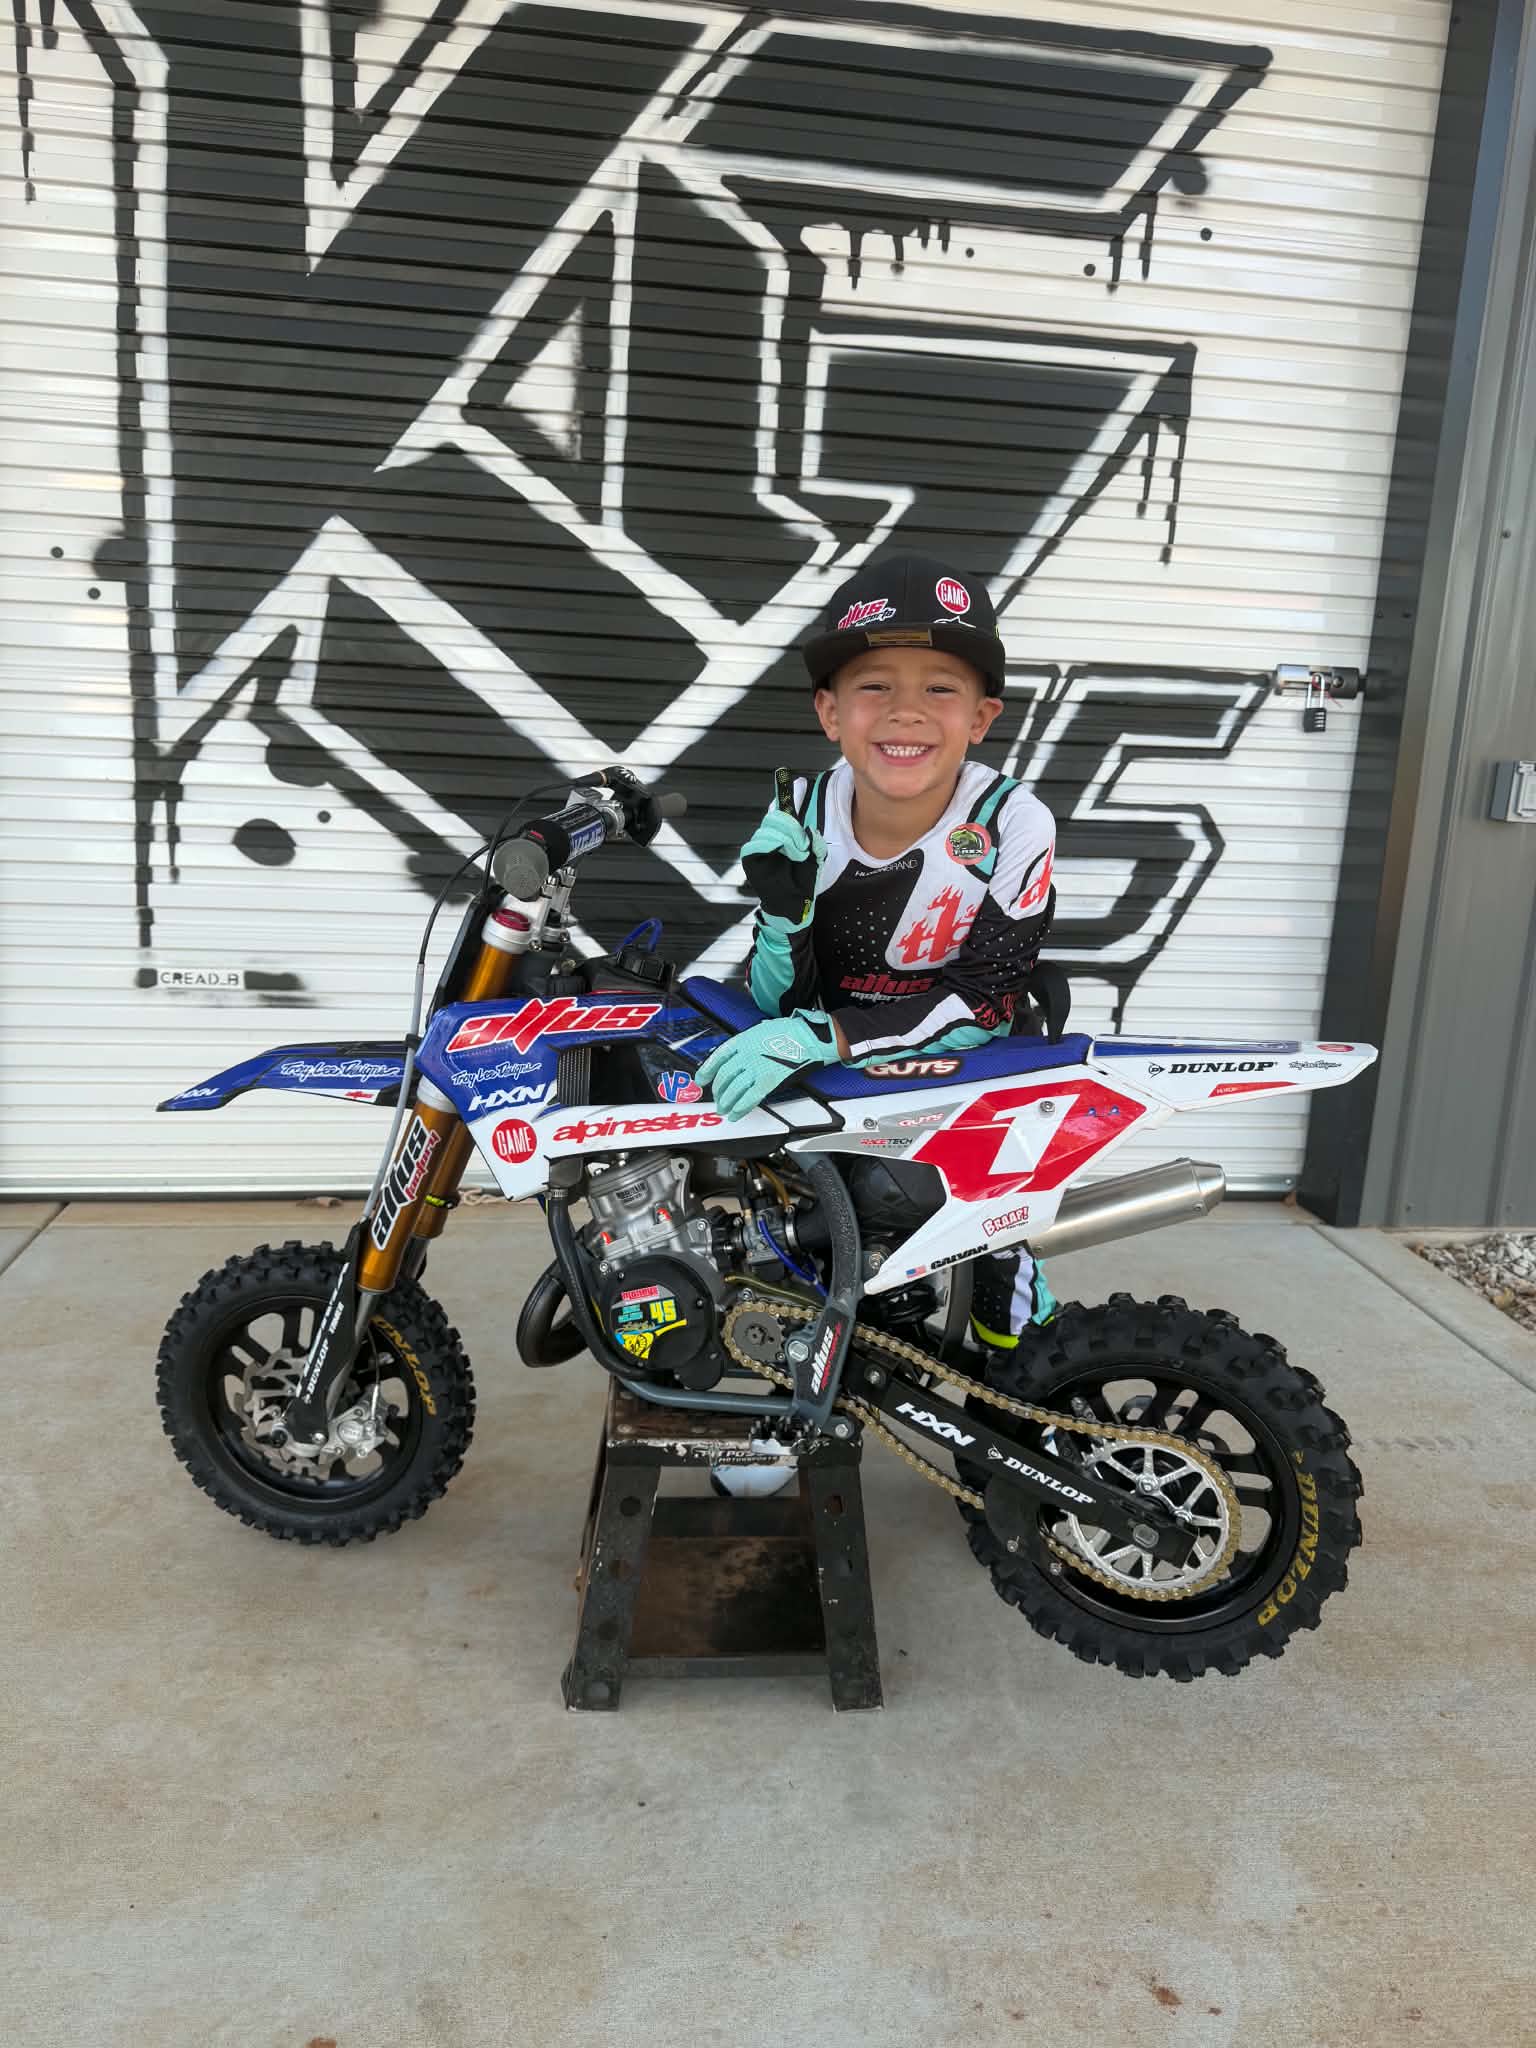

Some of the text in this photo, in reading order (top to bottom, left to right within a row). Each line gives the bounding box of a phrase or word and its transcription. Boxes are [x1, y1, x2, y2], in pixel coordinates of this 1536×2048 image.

[940, 583, 968, 608] GAME
[864, 1059, 960, 1076] GUTS
[1168, 1061, 1275, 1074] DUNLOP
[468, 1084, 546, 1111] HXN
[661, 1070, 692, 1103] VP
[496, 1127, 534, 1157] GAME
[553, 1112, 723, 1144] alpinestars
[989, 1093, 1081, 1176] 1
[982, 1206, 1029, 1237] BRAAP!
[306, 1338, 329, 1395] DUNLOP
[895, 1402, 976, 1447] HXN
[1003, 1456, 1097, 1504] DUNLOP
[1257, 1471, 1320, 1627] DUNLOP
